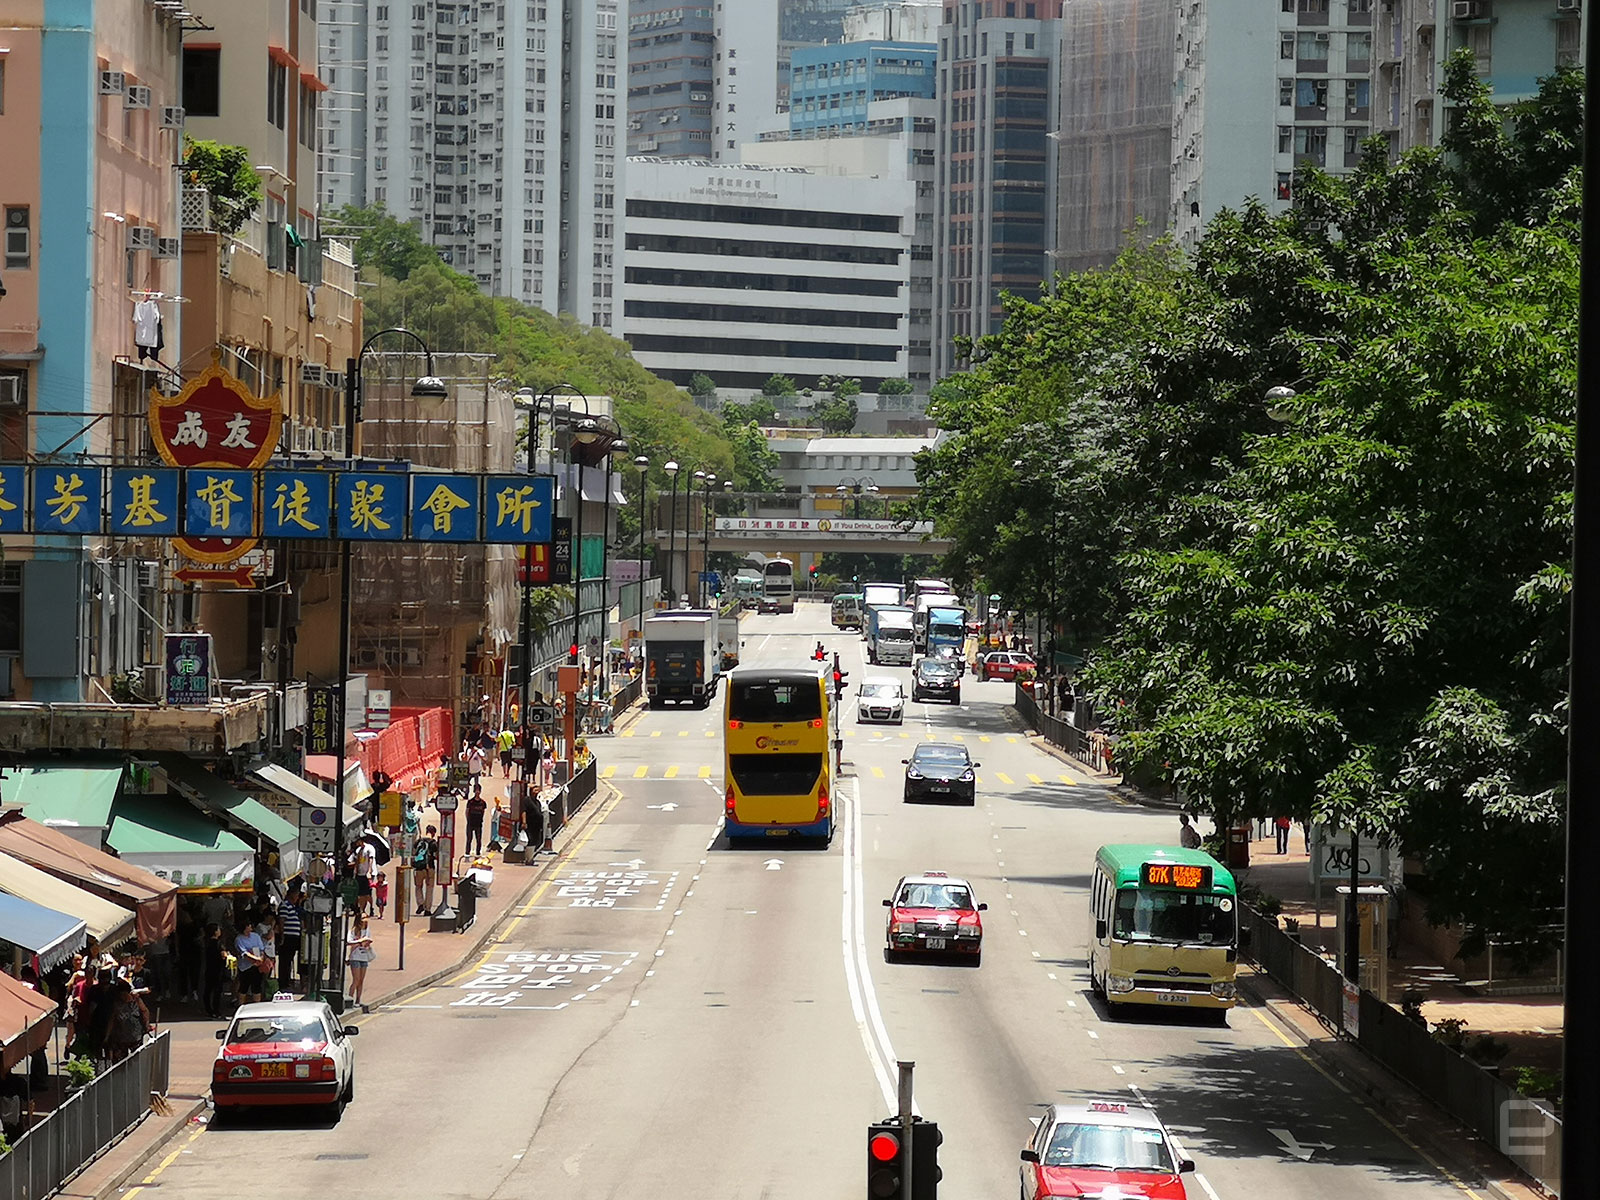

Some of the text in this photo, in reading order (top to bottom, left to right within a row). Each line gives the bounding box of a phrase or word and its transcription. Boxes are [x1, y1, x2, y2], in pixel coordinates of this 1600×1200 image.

[555, 544, 569, 555] 24
[323, 829, 329, 838] 7
[322, 842, 329, 850] 7
[569, 871, 650, 879] BUS
[1149, 866, 1169, 883] 87K
[556, 886, 640, 897] 巴士
[568, 896, 617, 908] 站
[503, 953, 603, 963] BUS
[476, 963, 612, 974] STOP
[459, 974, 573, 989] 巴士
[449, 991, 524, 1006] 站
[1092, 1103, 1126, 1112] TAXI
